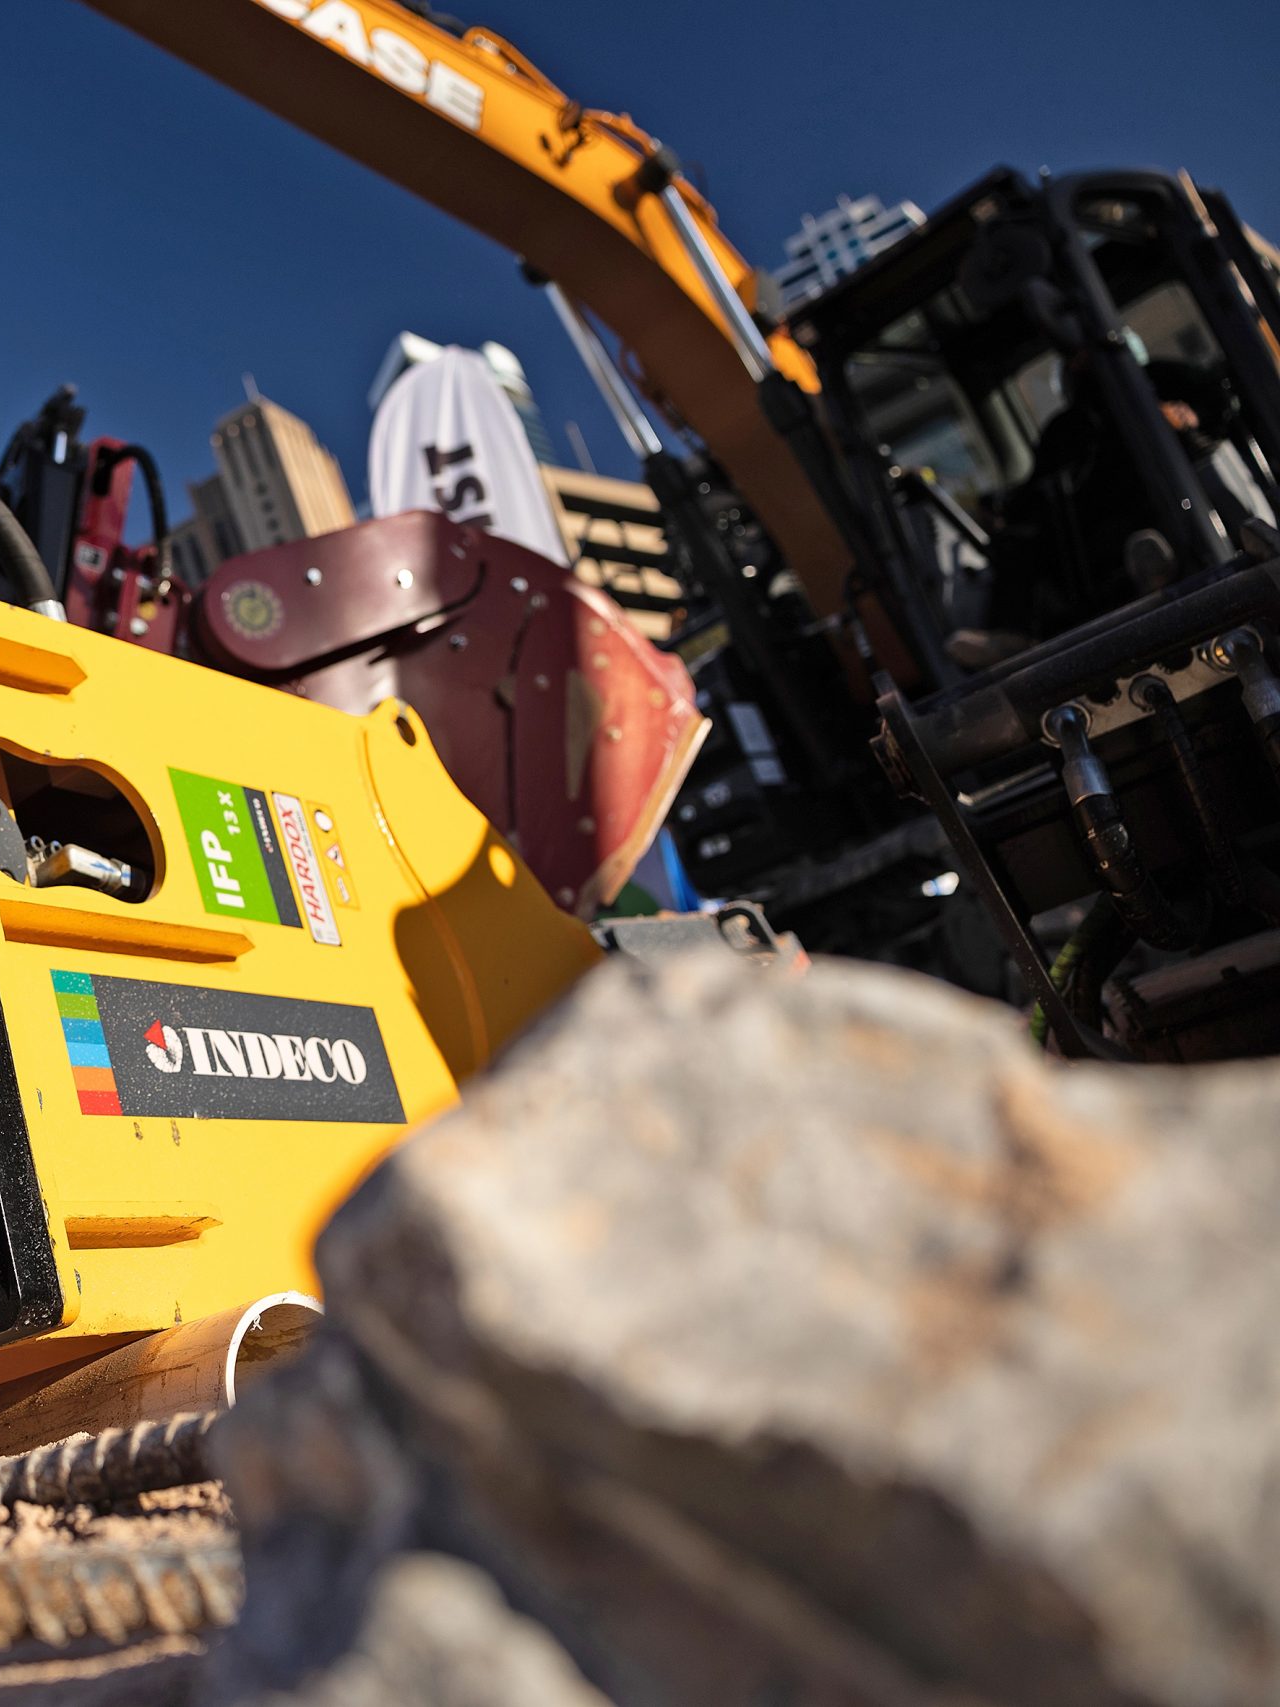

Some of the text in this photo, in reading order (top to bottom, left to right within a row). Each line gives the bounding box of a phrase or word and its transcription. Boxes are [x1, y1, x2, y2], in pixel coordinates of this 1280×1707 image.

[200, 829, 245, 909] IFP
[277, 798, 325, 922] HARDOX
[183, 1026, 367, 1085] INDECO
